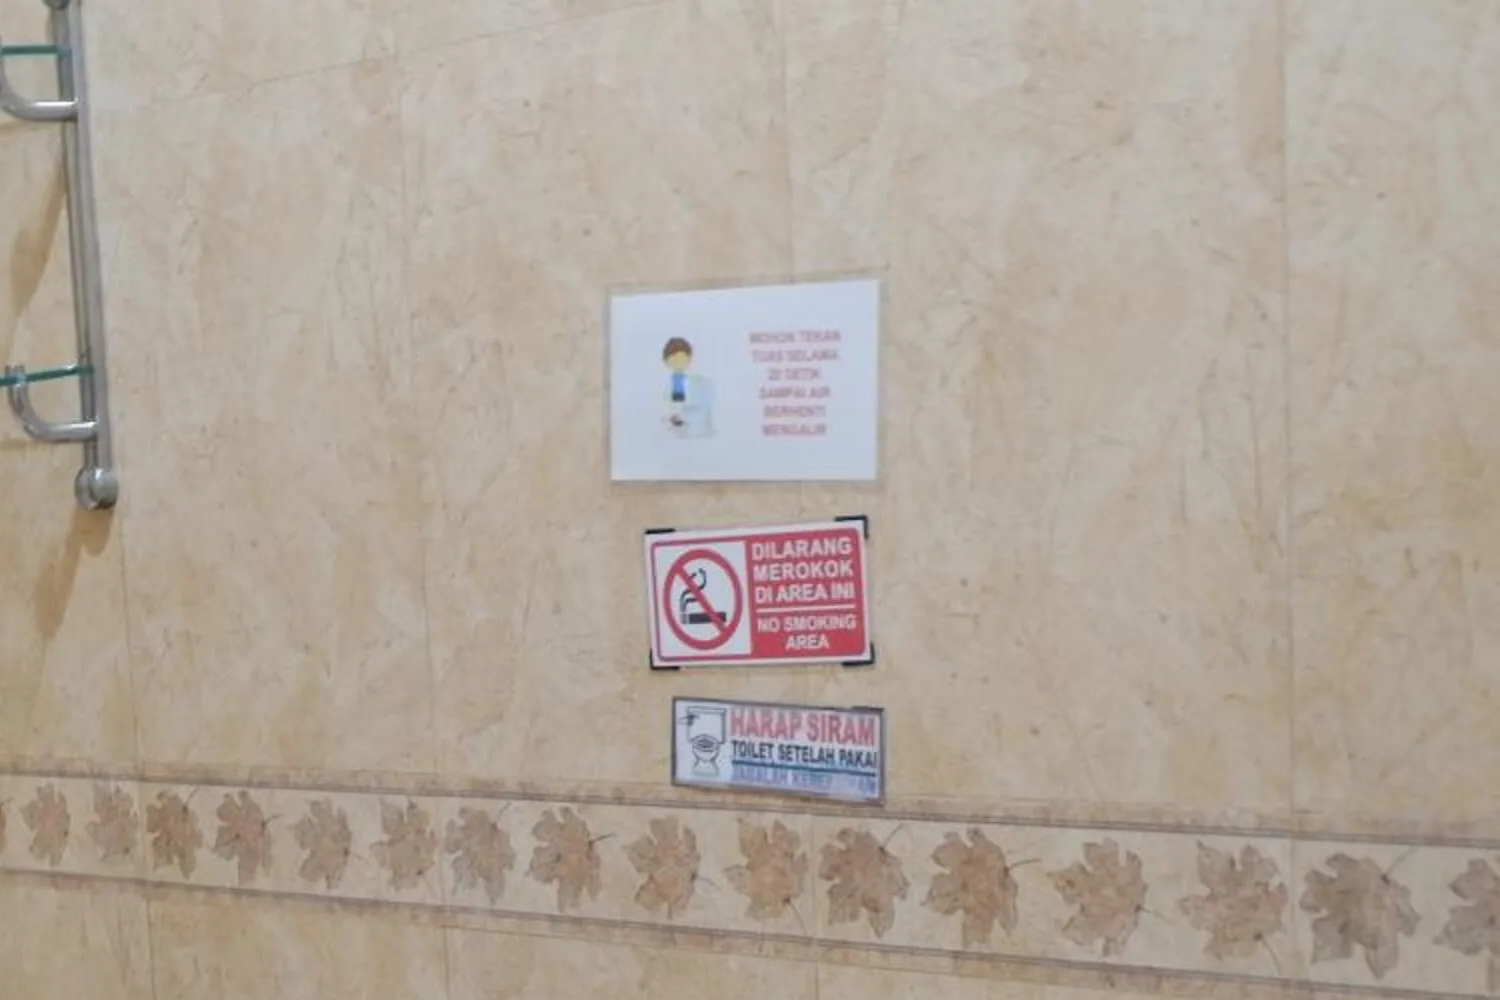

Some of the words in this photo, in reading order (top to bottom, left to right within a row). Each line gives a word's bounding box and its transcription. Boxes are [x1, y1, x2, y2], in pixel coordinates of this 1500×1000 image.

[800, 329, 842, 343] TEKAN
[752, 537, 853, 560] DILARANG
[753, 559, 854, 582] MEROKOK
[755, 585, 774, 604] DI
[776, 584, 828, 601] AREA
[831, 582, 855, 599] INI
[757, 616, 781, 632] NO
[783, 614, 856, 632] SMOKING
[786, 634, 829, 650] AREA
[730, 706, 802, 739] HARAP
[806, 711, 876, 746] SIRAM
[731, 740, 774, 759] TOILET
[778, 743, 835, 766] SETELAH
[839, 748, 878, 770] PAKAI
